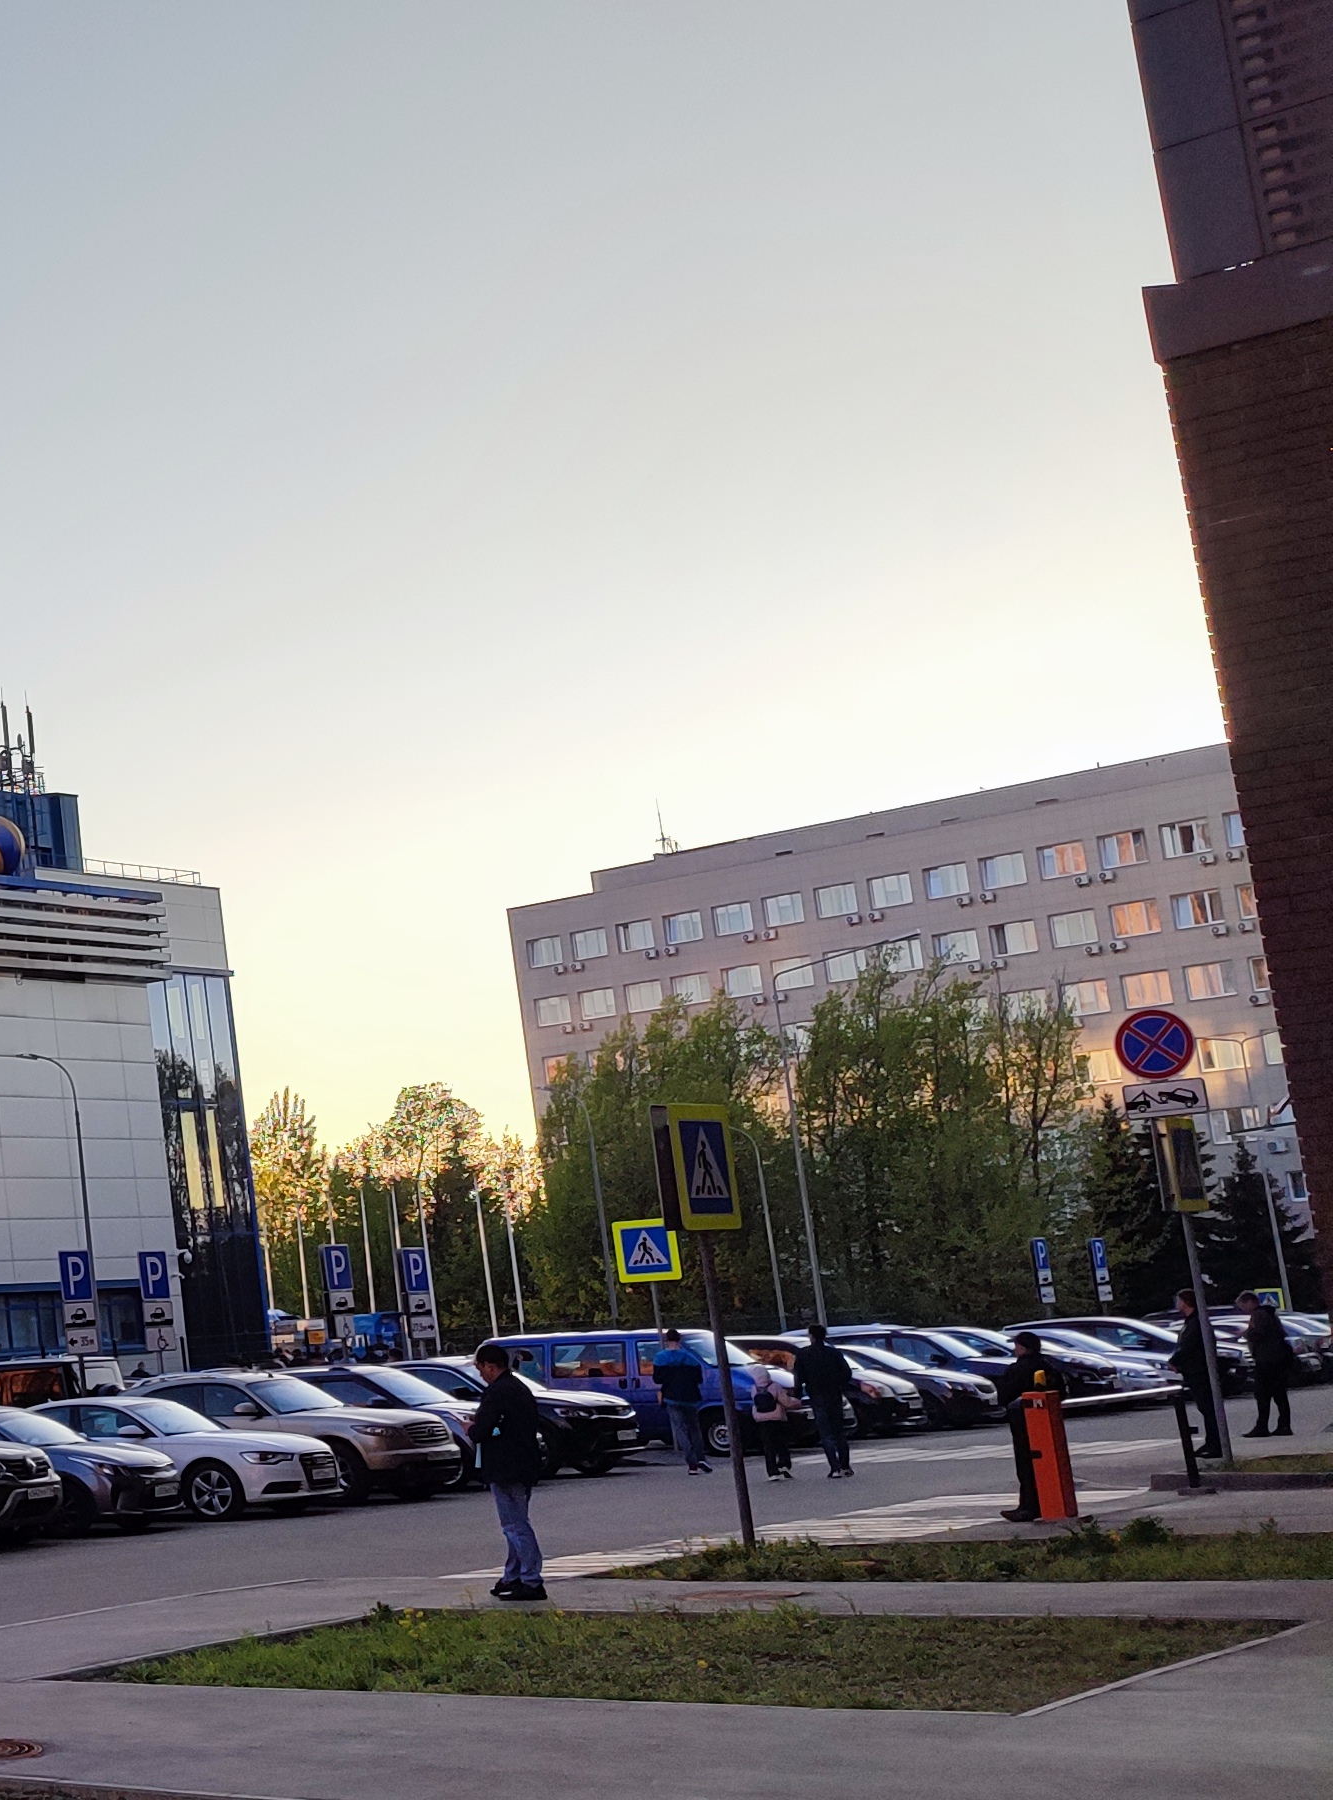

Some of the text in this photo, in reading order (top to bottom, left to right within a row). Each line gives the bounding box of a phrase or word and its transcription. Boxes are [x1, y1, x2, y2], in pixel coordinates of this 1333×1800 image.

[67, 1256, 85, 1296] P
[145, 1256, 162, 1295] P
[330, 1250, 346, 1286] P
[409, 1253, 423, 1288] P
